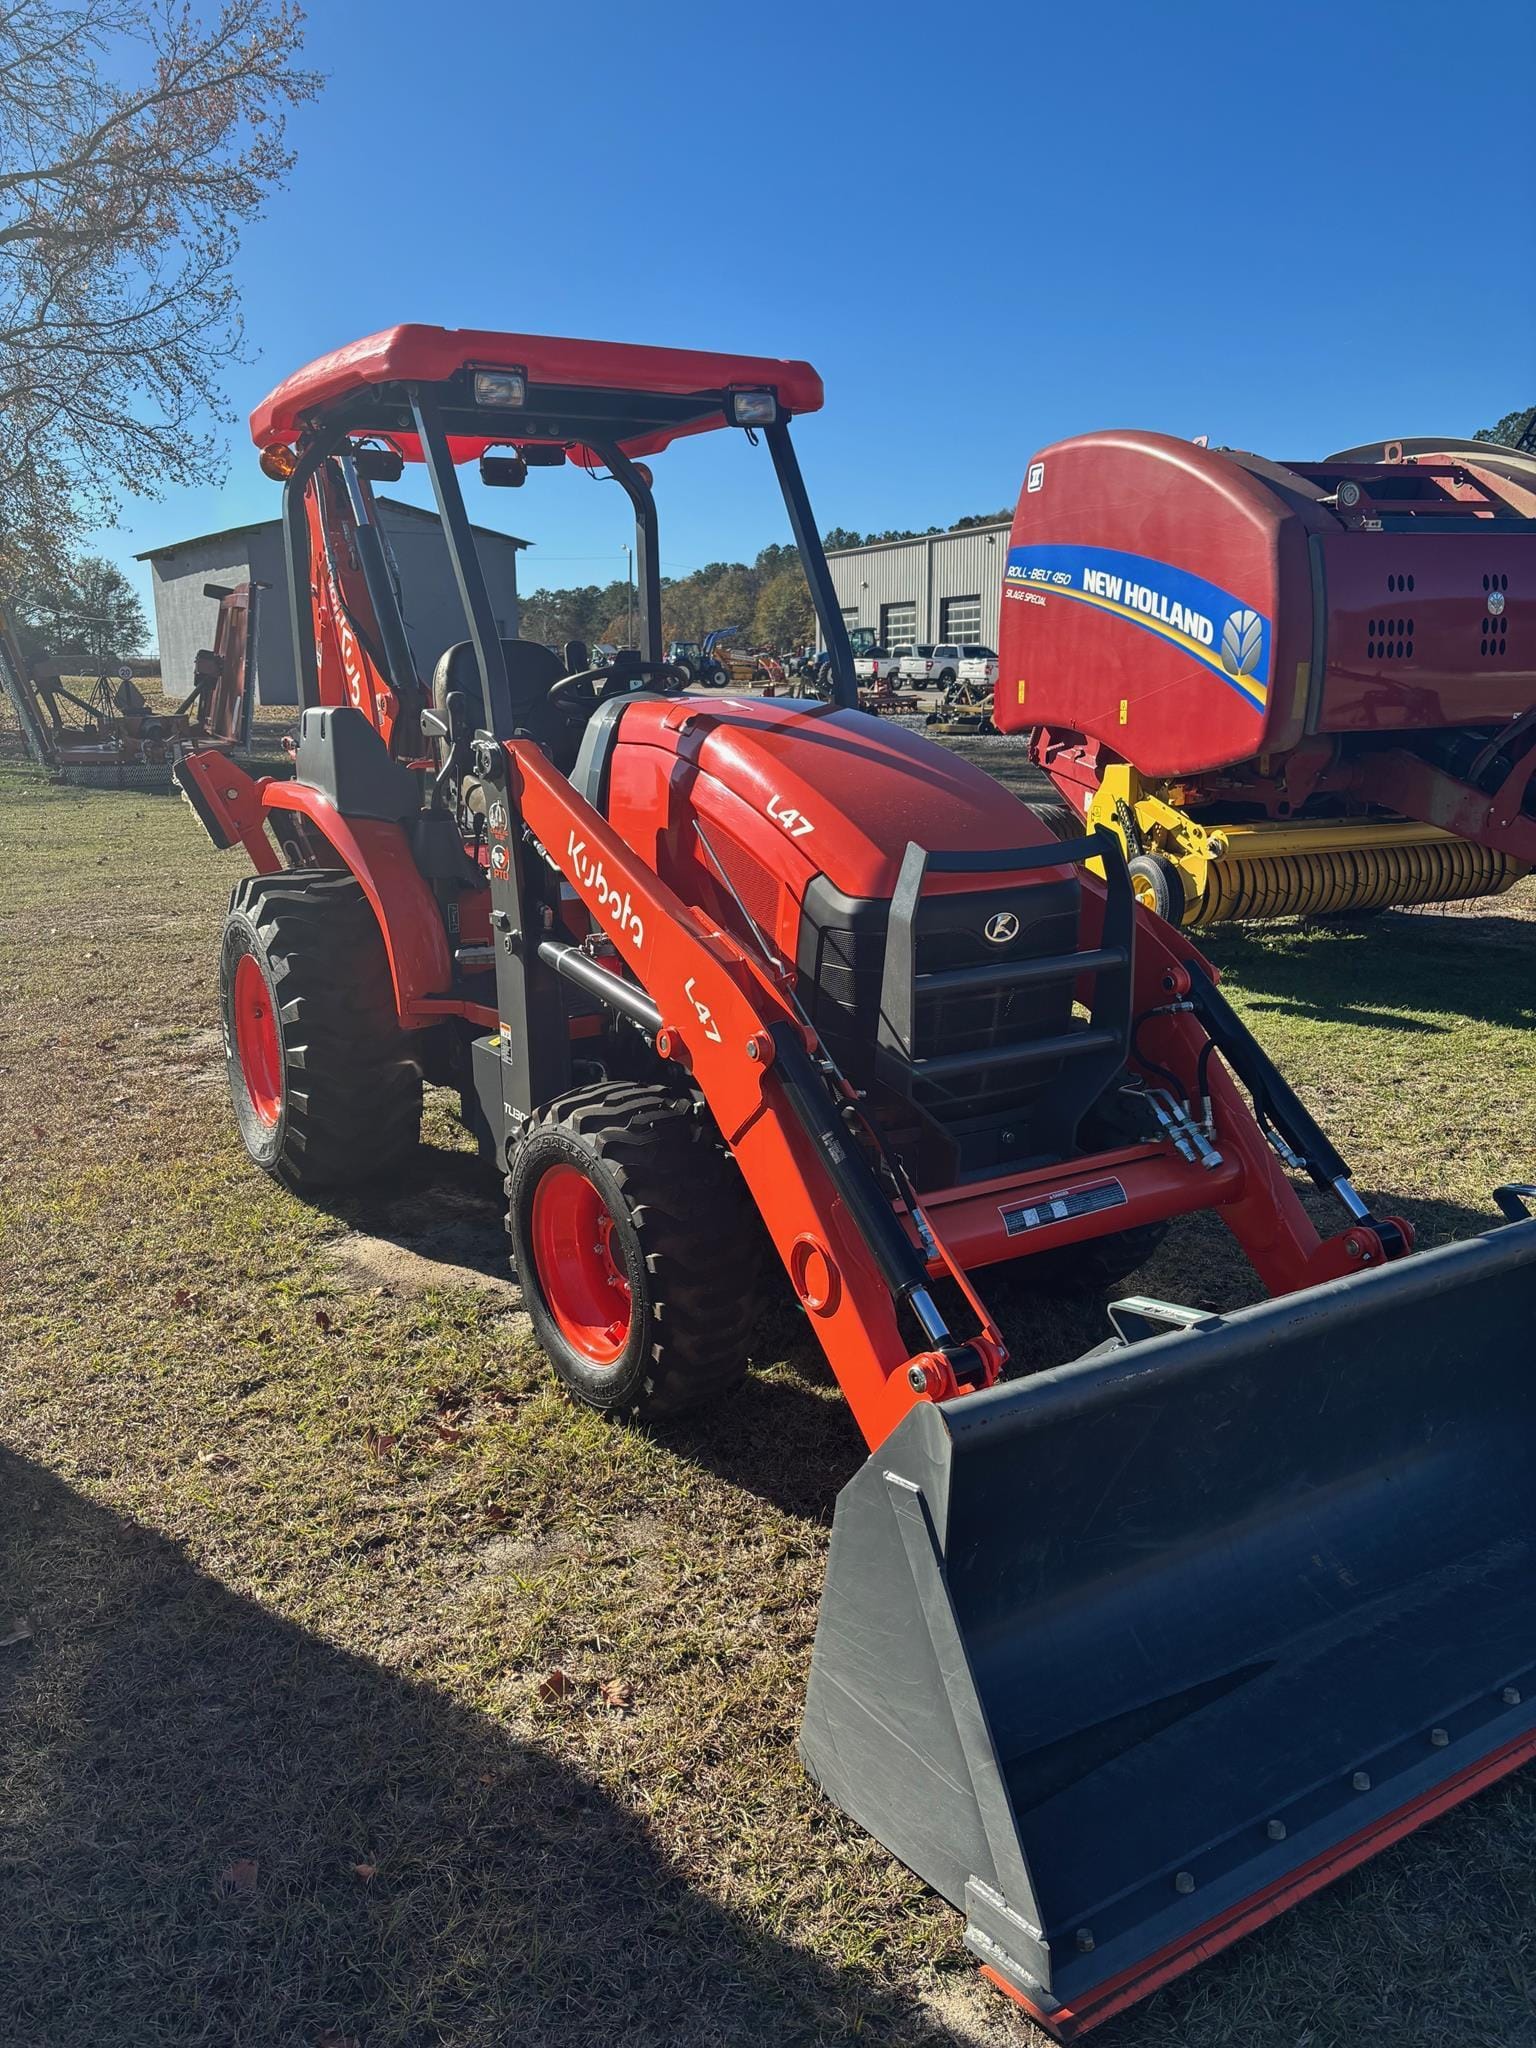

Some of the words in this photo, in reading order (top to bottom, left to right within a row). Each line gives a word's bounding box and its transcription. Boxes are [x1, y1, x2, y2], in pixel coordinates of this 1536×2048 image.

[1005, 588, 1025, 600] SILAGE
[1024, 592, 1046, 607] SPECIAL
[1052, 571, 1072, 585] 450
[1083, 567, 1122, 601] NEW
[1124, 582, 1214, 645] HOLLAND
[766, 793, 816, 837] L47
[494, 868, 510, 881] PTO
[567, 829, 644, 949] Kubota
[684, 976, 722, 1043] L47
